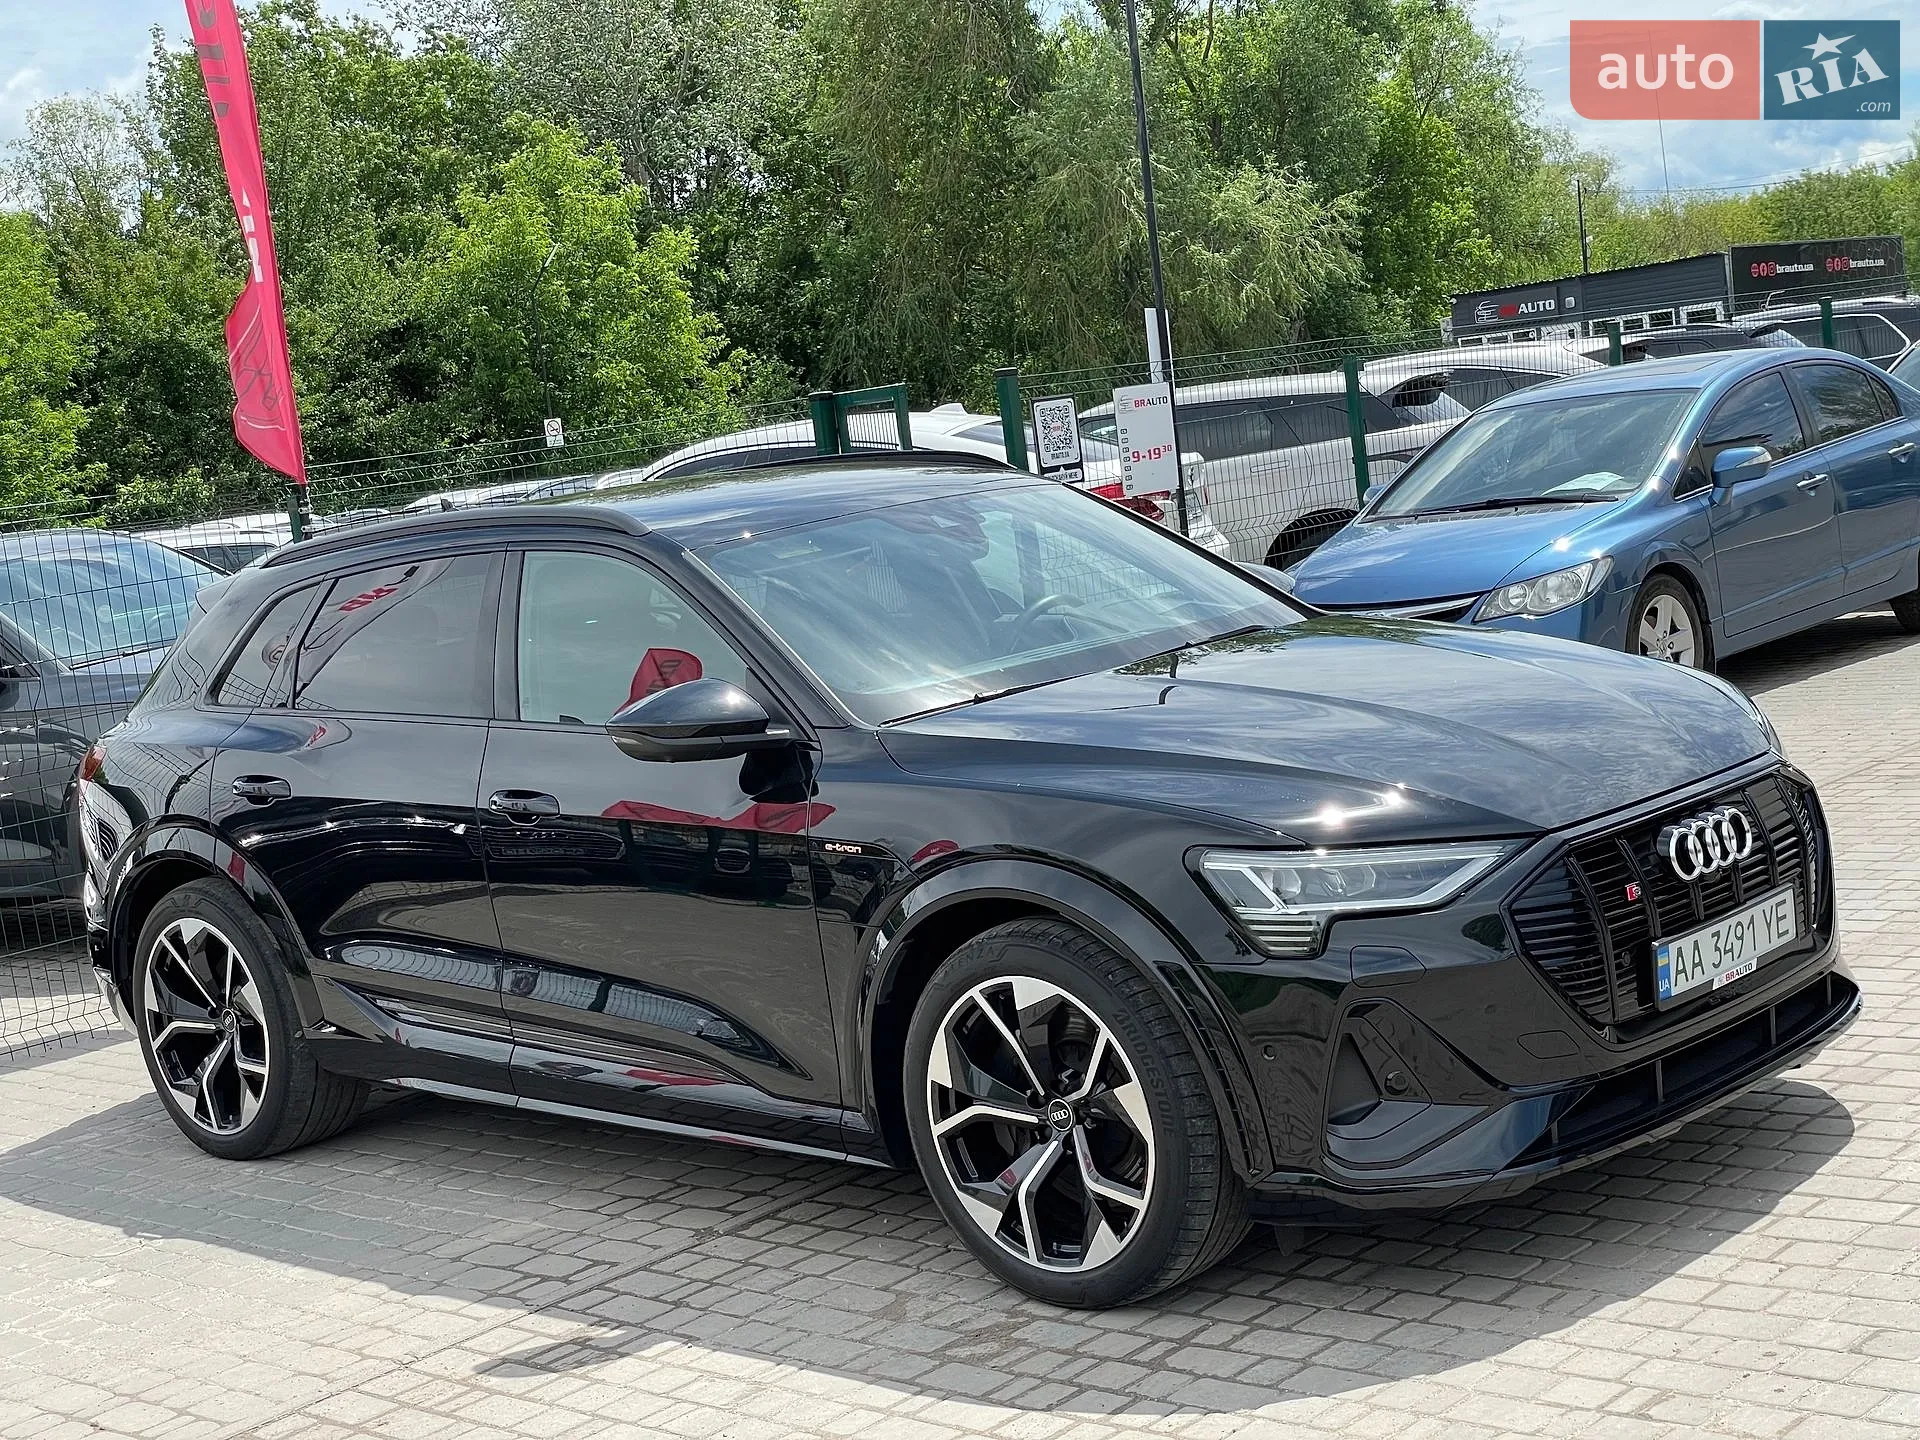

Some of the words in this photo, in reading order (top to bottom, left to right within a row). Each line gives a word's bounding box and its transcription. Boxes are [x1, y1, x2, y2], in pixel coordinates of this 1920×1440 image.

[1134, 396, 1168, 408] BRAUTO
[824, 843, 862, 854] e-tron
[1674, 939, 1705, 987] AA
[1710, 914, 1757, 969] 3491
[1762, 898, 1790, 945] YE
[1725, 963, 1753, 983] BRAUTO
[1658, 980, 1670, 993] UA
